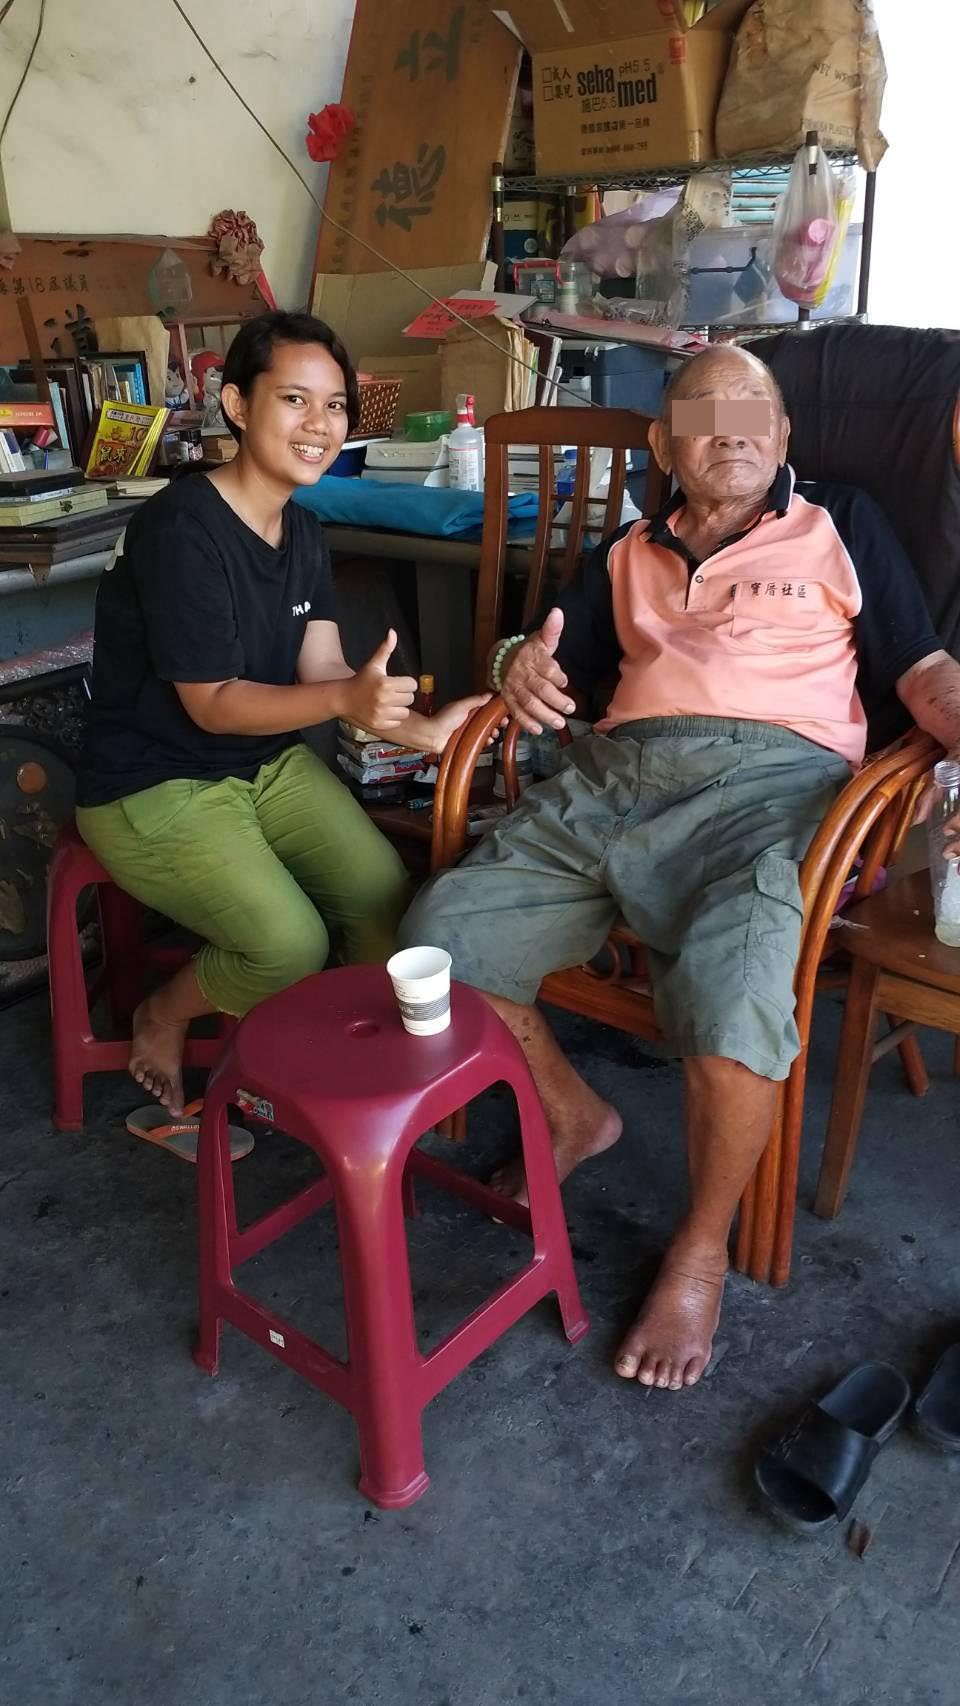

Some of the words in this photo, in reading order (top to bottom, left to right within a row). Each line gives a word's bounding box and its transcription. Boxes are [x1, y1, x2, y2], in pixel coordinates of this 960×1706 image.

[576, 64, 615, 97] seba
[617, 59, 651, 79] pH5.5
[617, 72, 658, 108] med
[369, 141, 446, 232] 德
